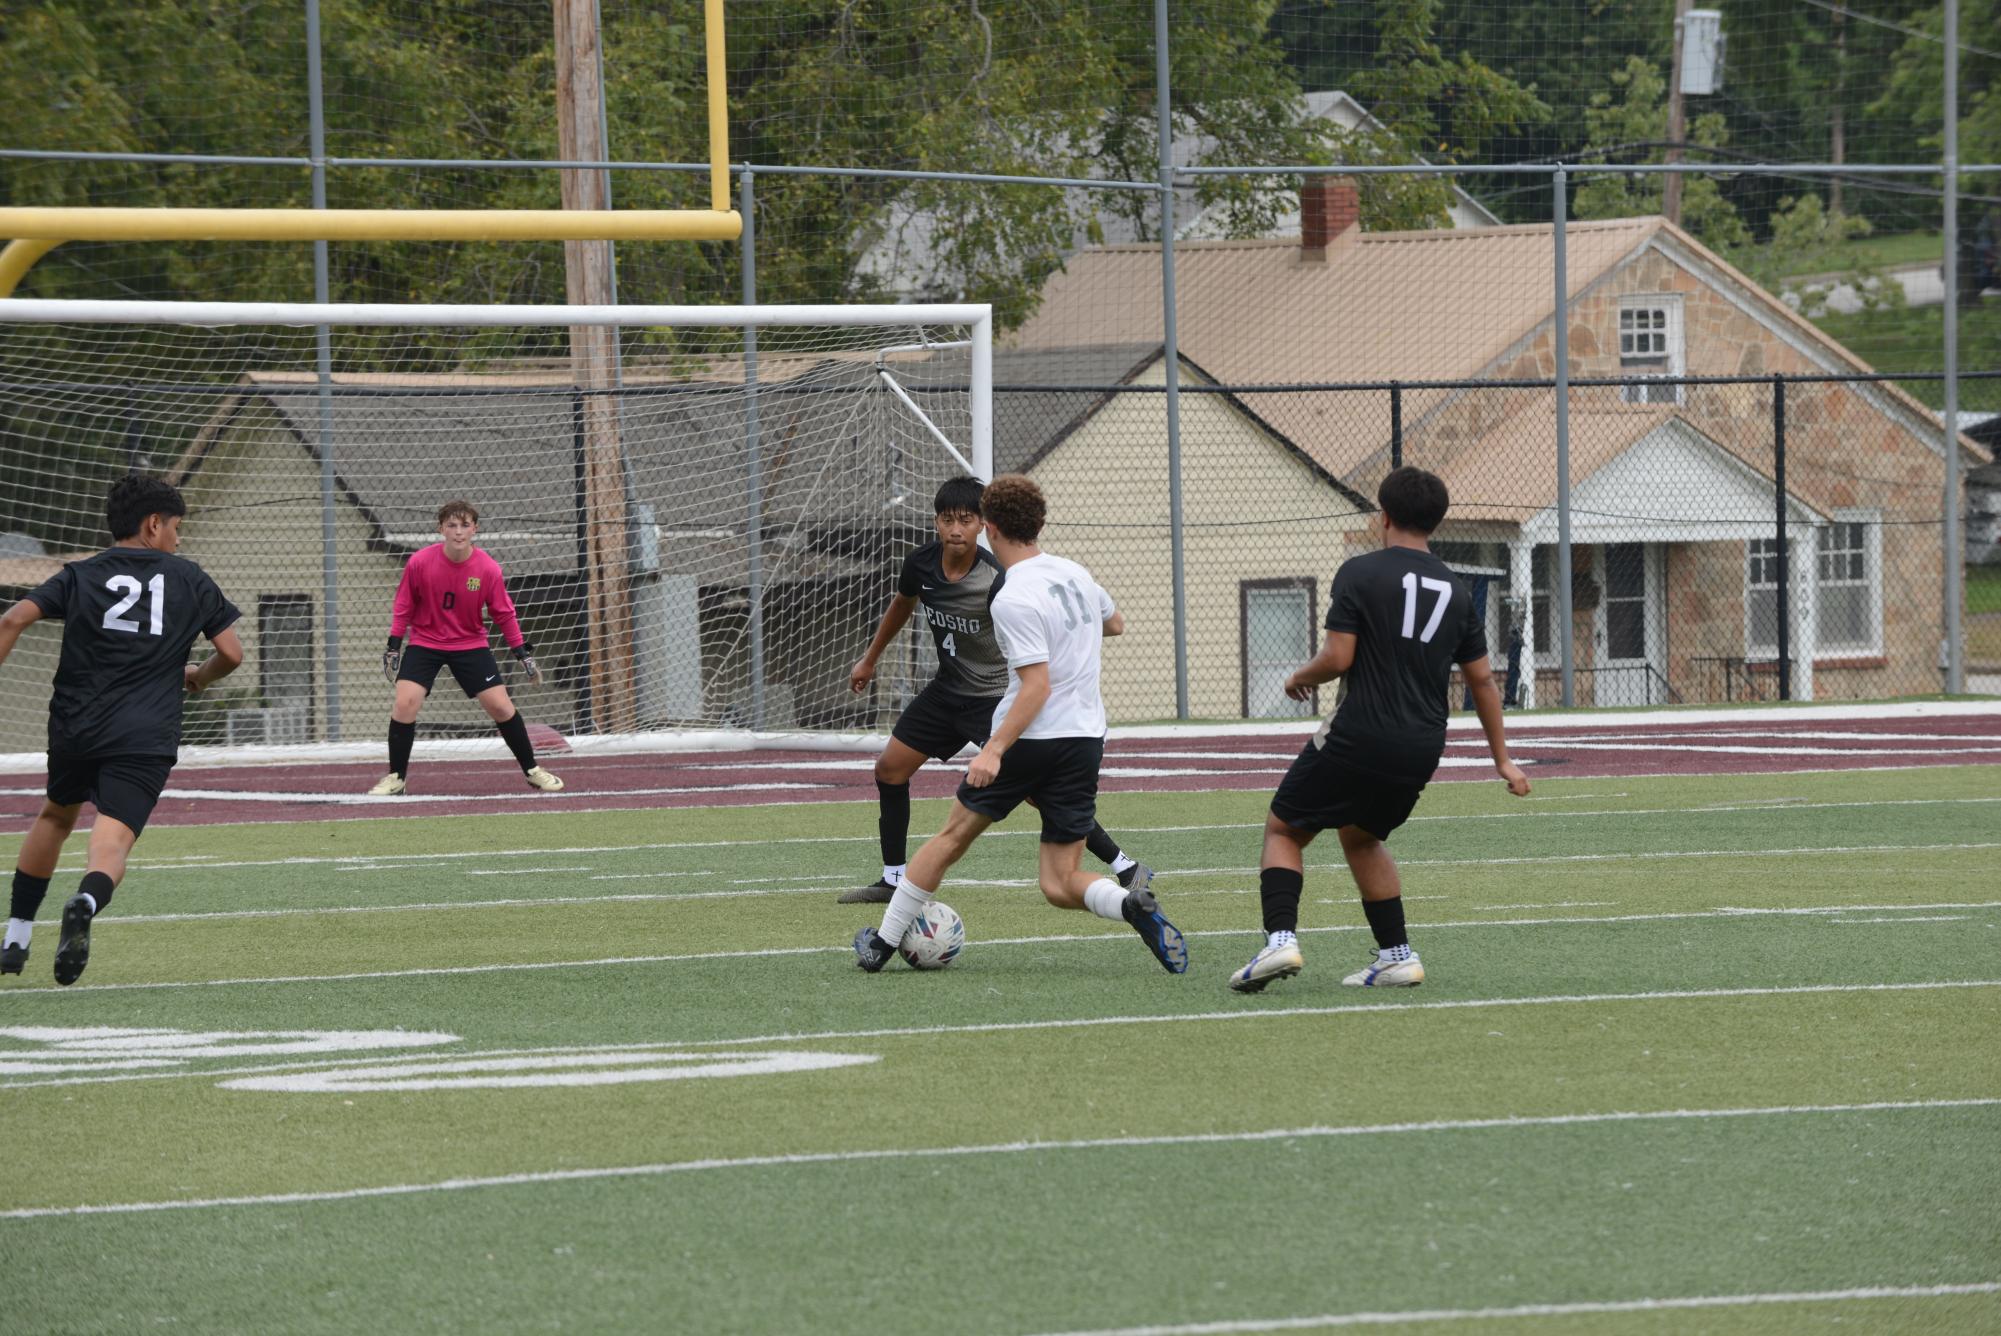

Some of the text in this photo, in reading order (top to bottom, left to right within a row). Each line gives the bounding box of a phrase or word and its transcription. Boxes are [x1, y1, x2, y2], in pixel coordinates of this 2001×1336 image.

[102, 573, 165, 636] 21
[442, 591, 456, 610] 0
[1401, 571, 1453, 644] 17
[925, 605, 981, 635] EOSHO
[942, 632, 956, 657] 4
